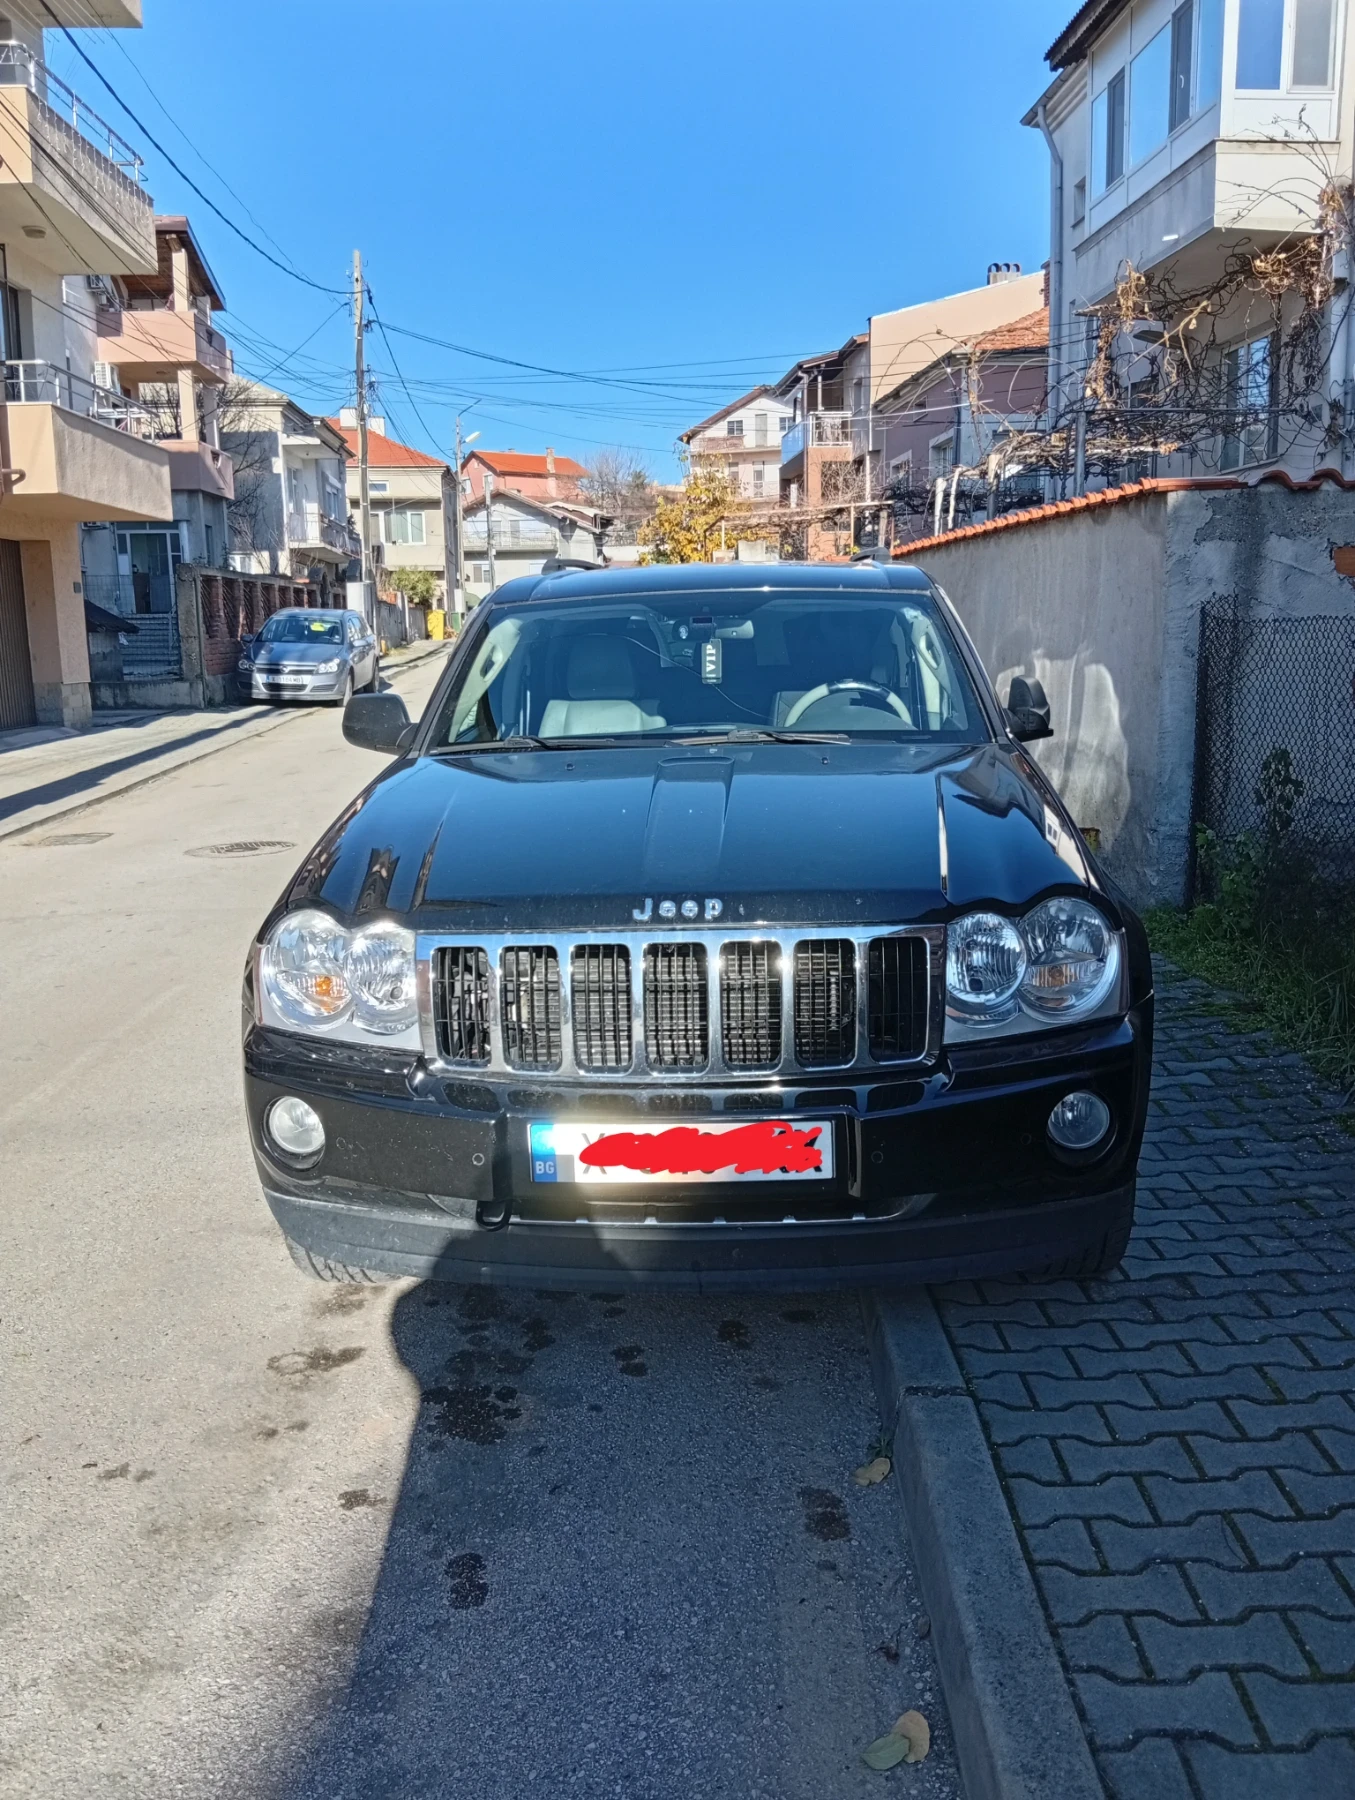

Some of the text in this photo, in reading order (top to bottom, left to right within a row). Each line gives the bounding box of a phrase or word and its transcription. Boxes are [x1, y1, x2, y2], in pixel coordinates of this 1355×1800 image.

[705, 644, 717, 673] VIP
[632, 898, 723, 921] Jeep
[535, 1161, 555, 1174] BG
